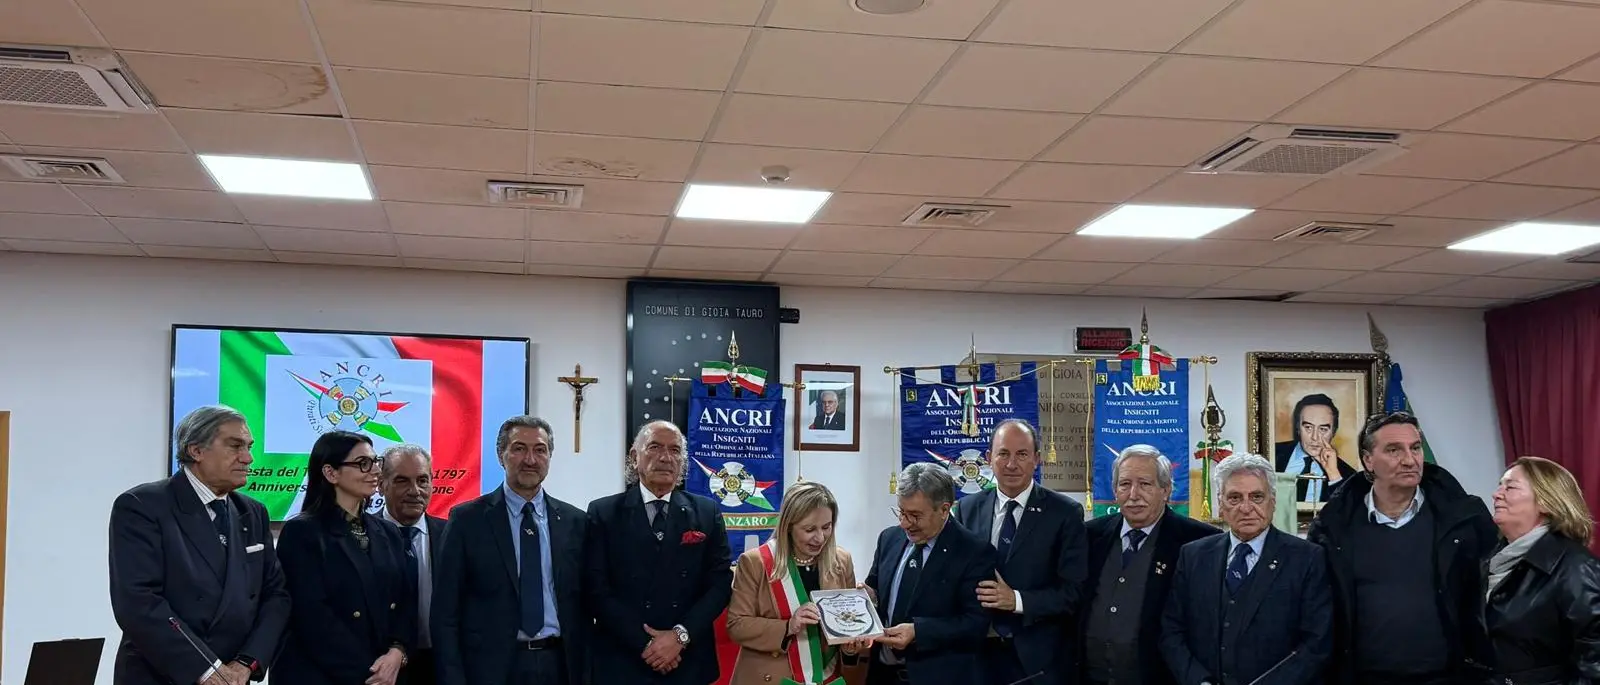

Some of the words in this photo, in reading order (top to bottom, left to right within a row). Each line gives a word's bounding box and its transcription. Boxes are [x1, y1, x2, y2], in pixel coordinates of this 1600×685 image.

[645, 305, 679, 316] COMUNE
[685, 306, 695, 316] DI
[702, 307, 729, 317] GIOIA
[736, 308, 763, 318] TAURO
[1081, 338, 1126, 347] INCENDIO
[319, 361, 393, 397] ANCRI
[1052, 368, 1083, 379] GIOIA
[1106, 381, 1177, 396] ANRI
[926, 386, 1012, 407] ANRI
[699, 406, 773, 426] ANCRI
[713, 433, 756, 443] INSIGNITI
[247, 467, 273, 477] esta
[277, 466, 299, 477] del
[303, 467, 311, 477] T
[432, 468, 467, 479] 1797
[247, 481, 307, 492] Annivers
[432, 486, 455, 494] one
[369, 498, 384, 508] 19
[725, 516, 768, 526] NZARO
